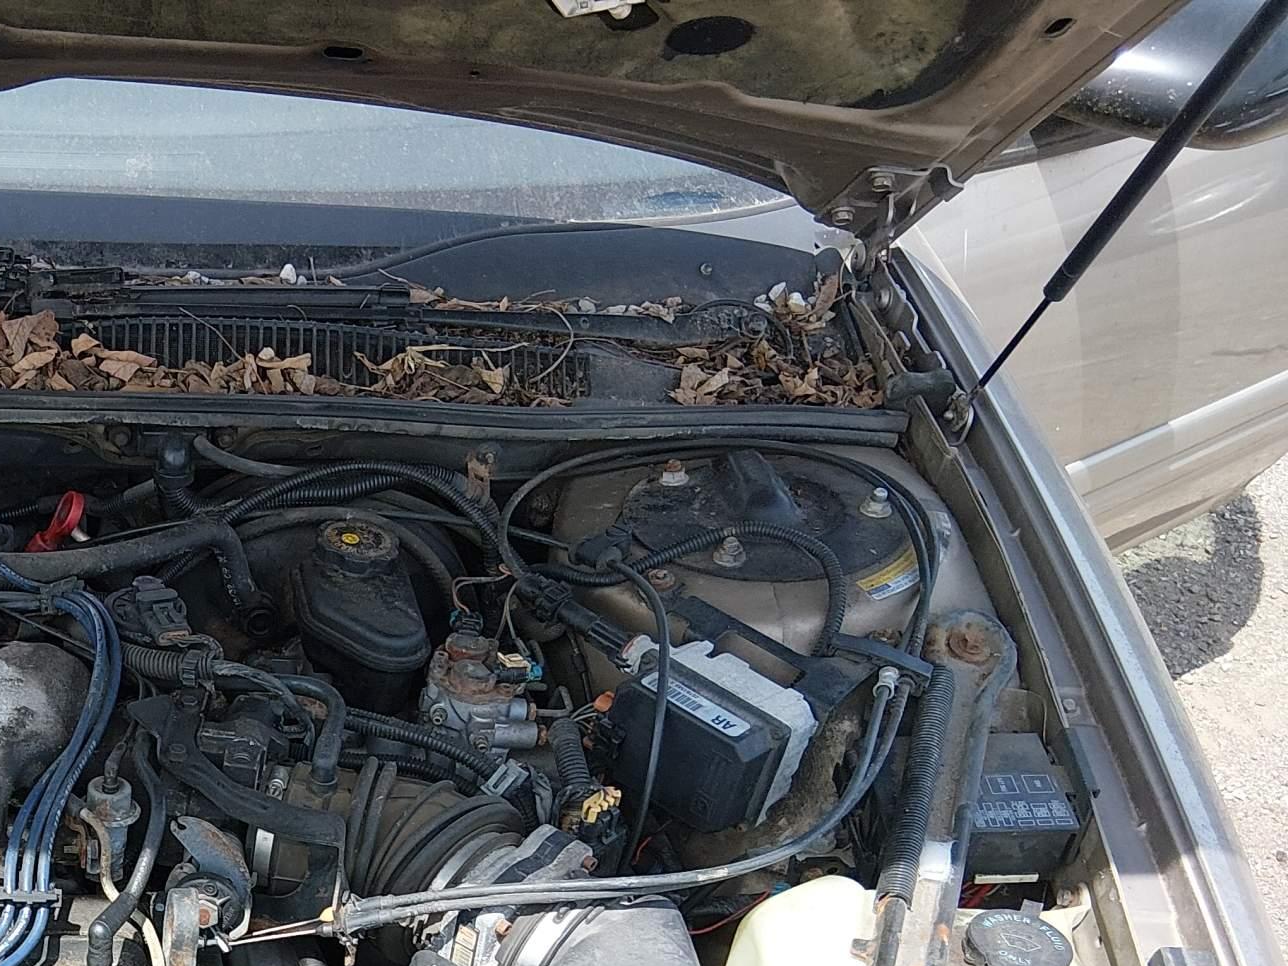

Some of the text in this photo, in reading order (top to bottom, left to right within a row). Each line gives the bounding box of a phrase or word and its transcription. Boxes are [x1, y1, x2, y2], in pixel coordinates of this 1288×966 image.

[710, 714, 737, 730] AR
[981, 913, 1066, 952] WASHER FLUID
[999, 949, 1032, 966] ONLY
